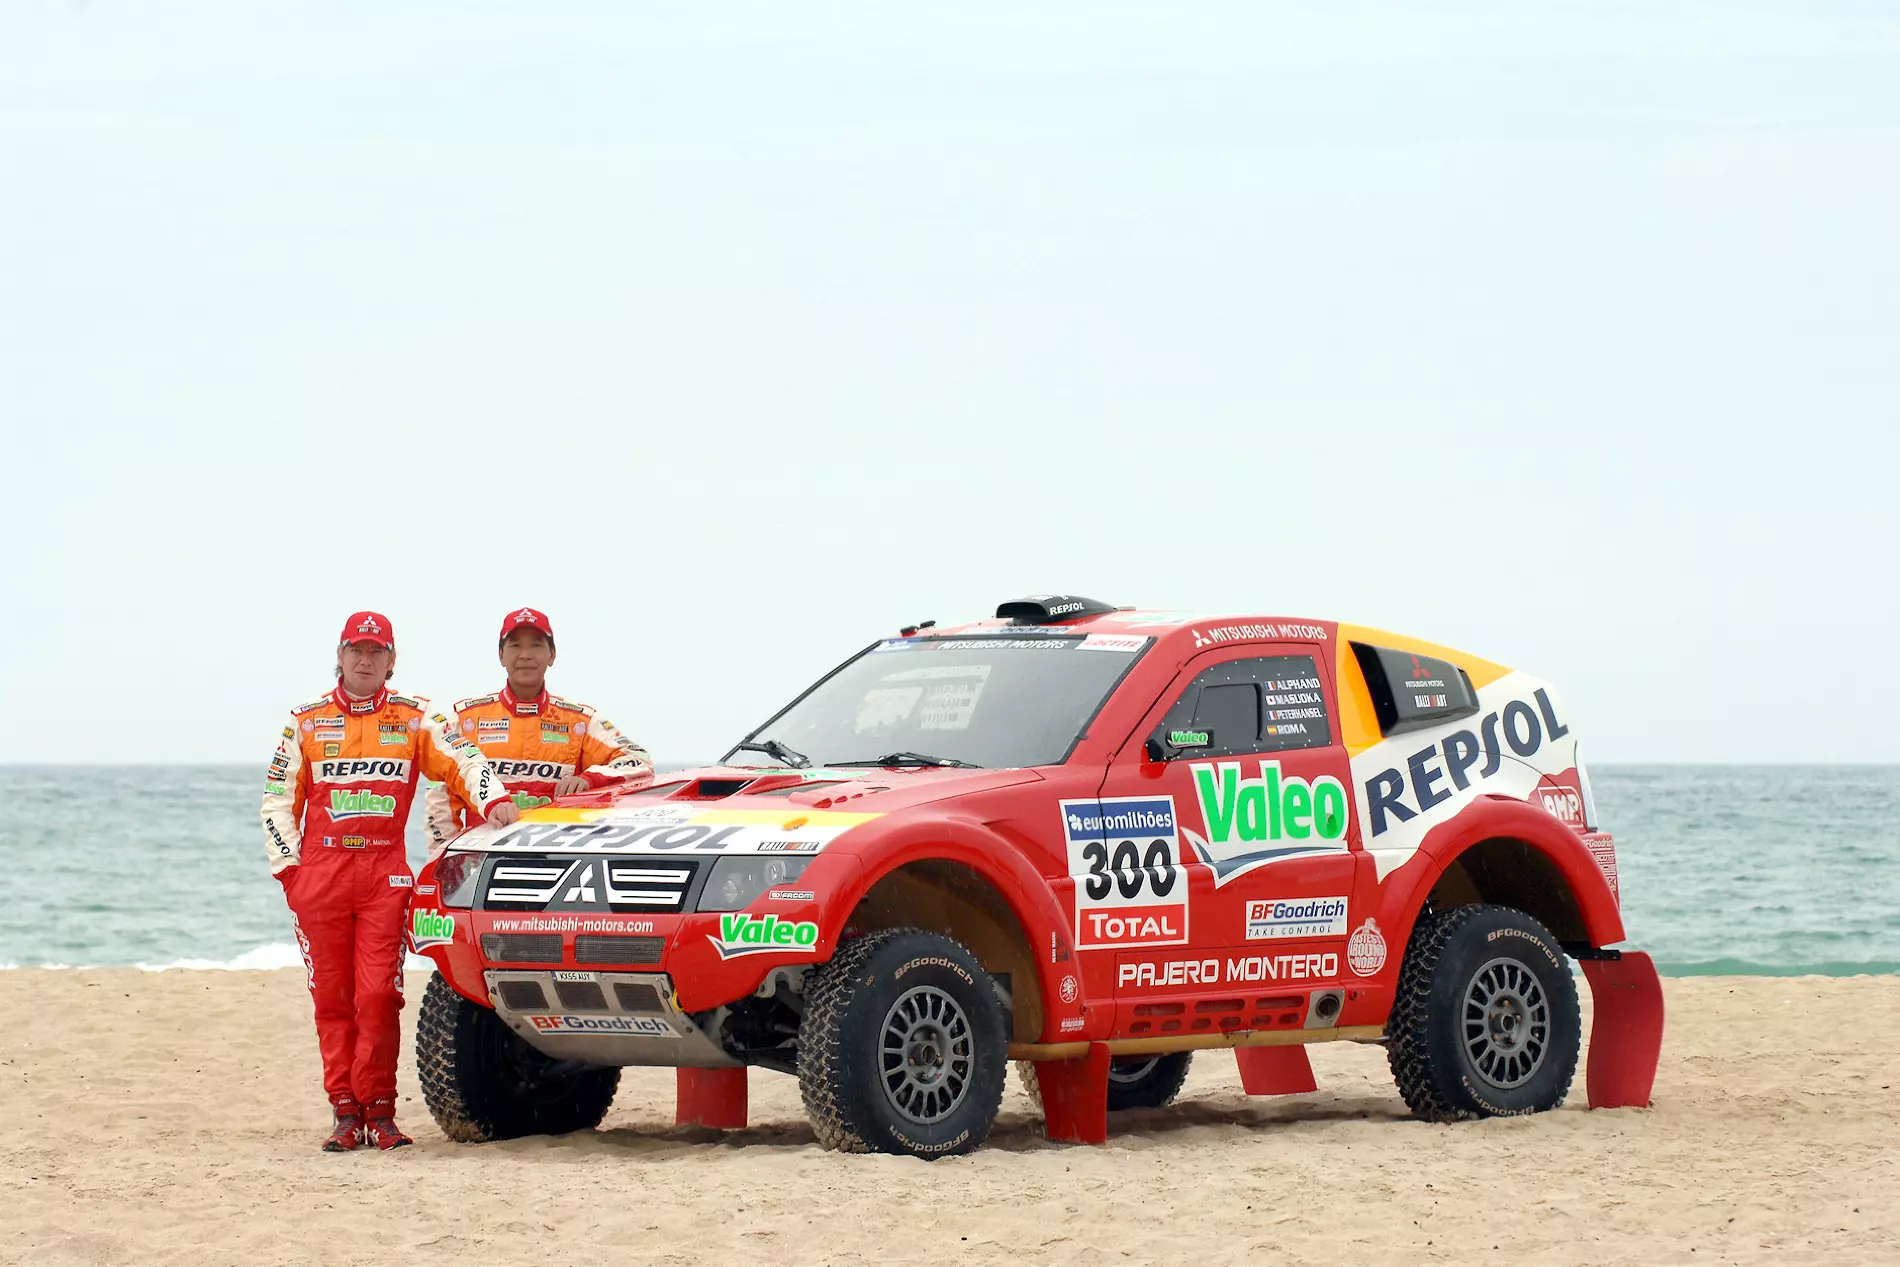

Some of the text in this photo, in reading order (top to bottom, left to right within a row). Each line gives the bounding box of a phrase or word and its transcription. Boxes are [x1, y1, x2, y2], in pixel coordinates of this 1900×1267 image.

[1049, 602, 1085, 616] REPSOL
[1084, 638, 1142, 648] LOCTITE
[1207, 624, 1328, 643] MITSUBISHI MOTORS
[937, 638, 1069, 650] MITSUBISHI MOTORS
[1277, 678, 1321, 690] ALPHAND
[1275, 692, 1322, 704] MASUOKA
[1276, 707, 1323, 720] PETERHANSEL
[1171, 730, 1209, 744] Valeo
[1277, 723, 1308, 735] ROMA
[322, 761, 404, 777] REPSOL
[1364, 687, 1570, 838] REPSOL
[331, 790, 396, 813] Valeo
[1191, 763, 1346, 844] Valeo
[1083, 811, 1172, 831] euromilhões
[492, 824, 746, 850] REPSOL
[1082, 839, 1177, 900] 300
[1251, 900, 1345, 920] BFGoodrich
[413, 909, 454, 939] Valeo
[492, 916, 654, 933] www.mitsubishi-motors.com
[721, 914, 817, 946] Valeo
[1088, 913, 1177, 939] TOTAL
[1248, 925, 1332, 937] TAKE CONTROL
[1486, 927, 1560, 969] BFGoodrich
[894, 957, 974, 986] BFGoodrich
[1118, 953, 1339, 988] PAJERO MONTERO
[530, 1015, 670, 1033] BFGoodrich
[889, 1125, 970, 1153] BFGoodrich
